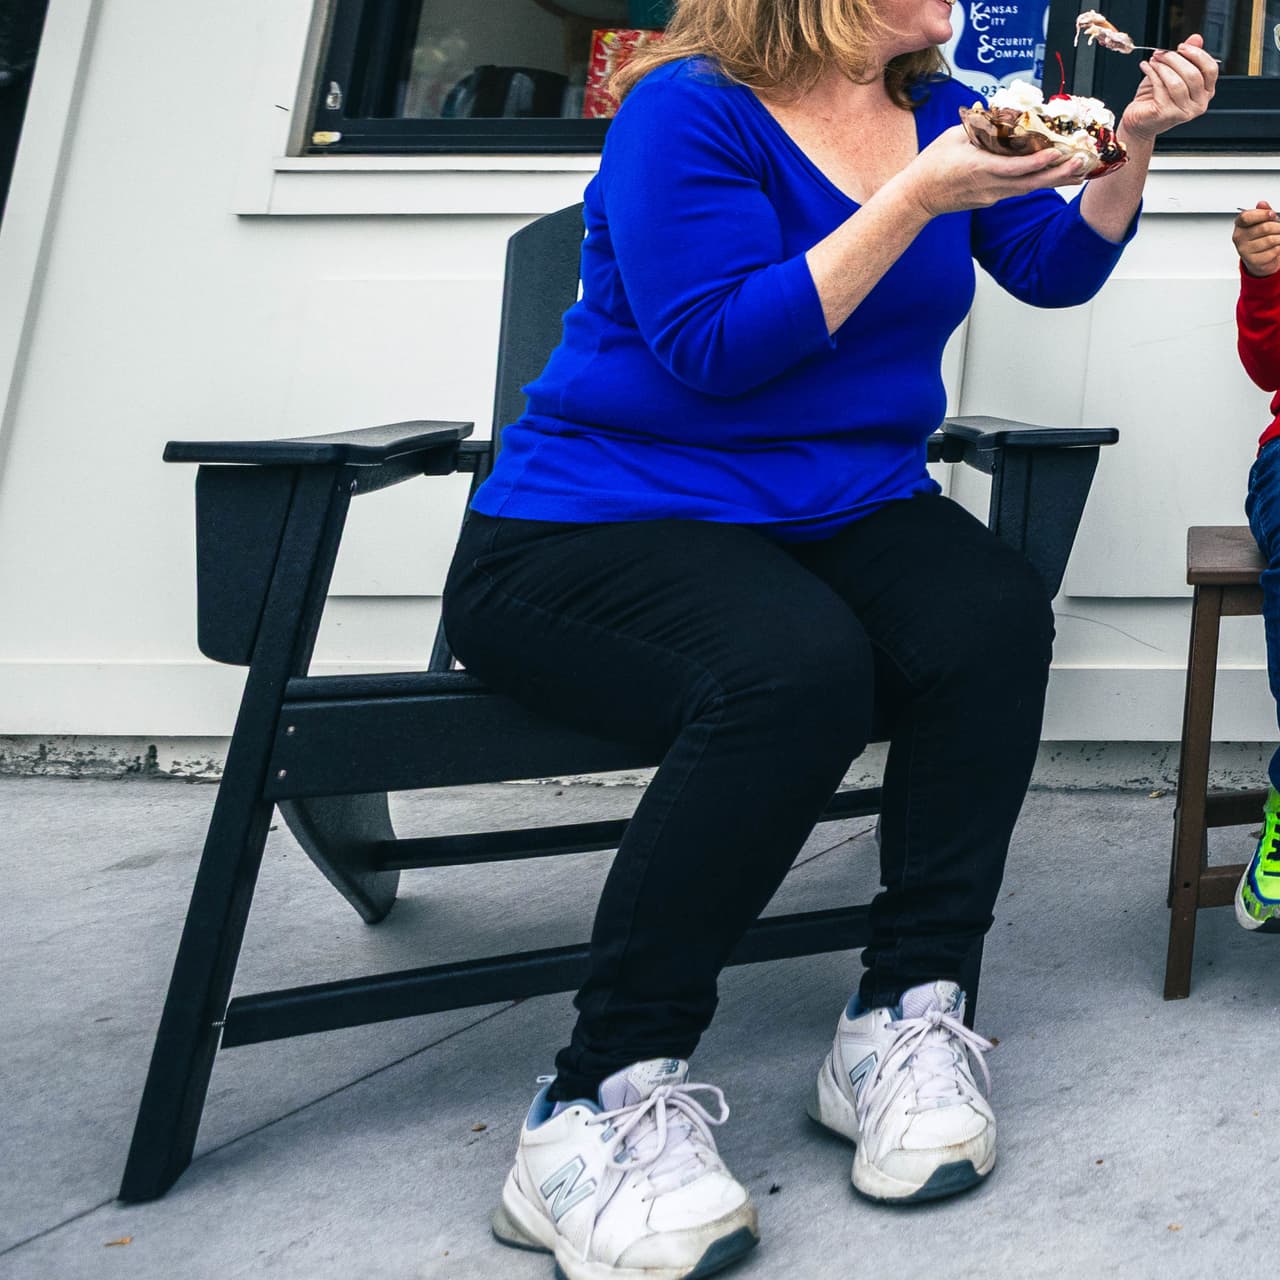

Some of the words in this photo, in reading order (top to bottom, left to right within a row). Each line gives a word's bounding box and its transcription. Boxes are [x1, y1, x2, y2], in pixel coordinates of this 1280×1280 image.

[970, 1, 1019, 20] KANSAS
[972, 13, 1007, 32] CITY
[979, 34, 1034, 53] SECURITY
[977, 47, 1034, 63] COMPAN
